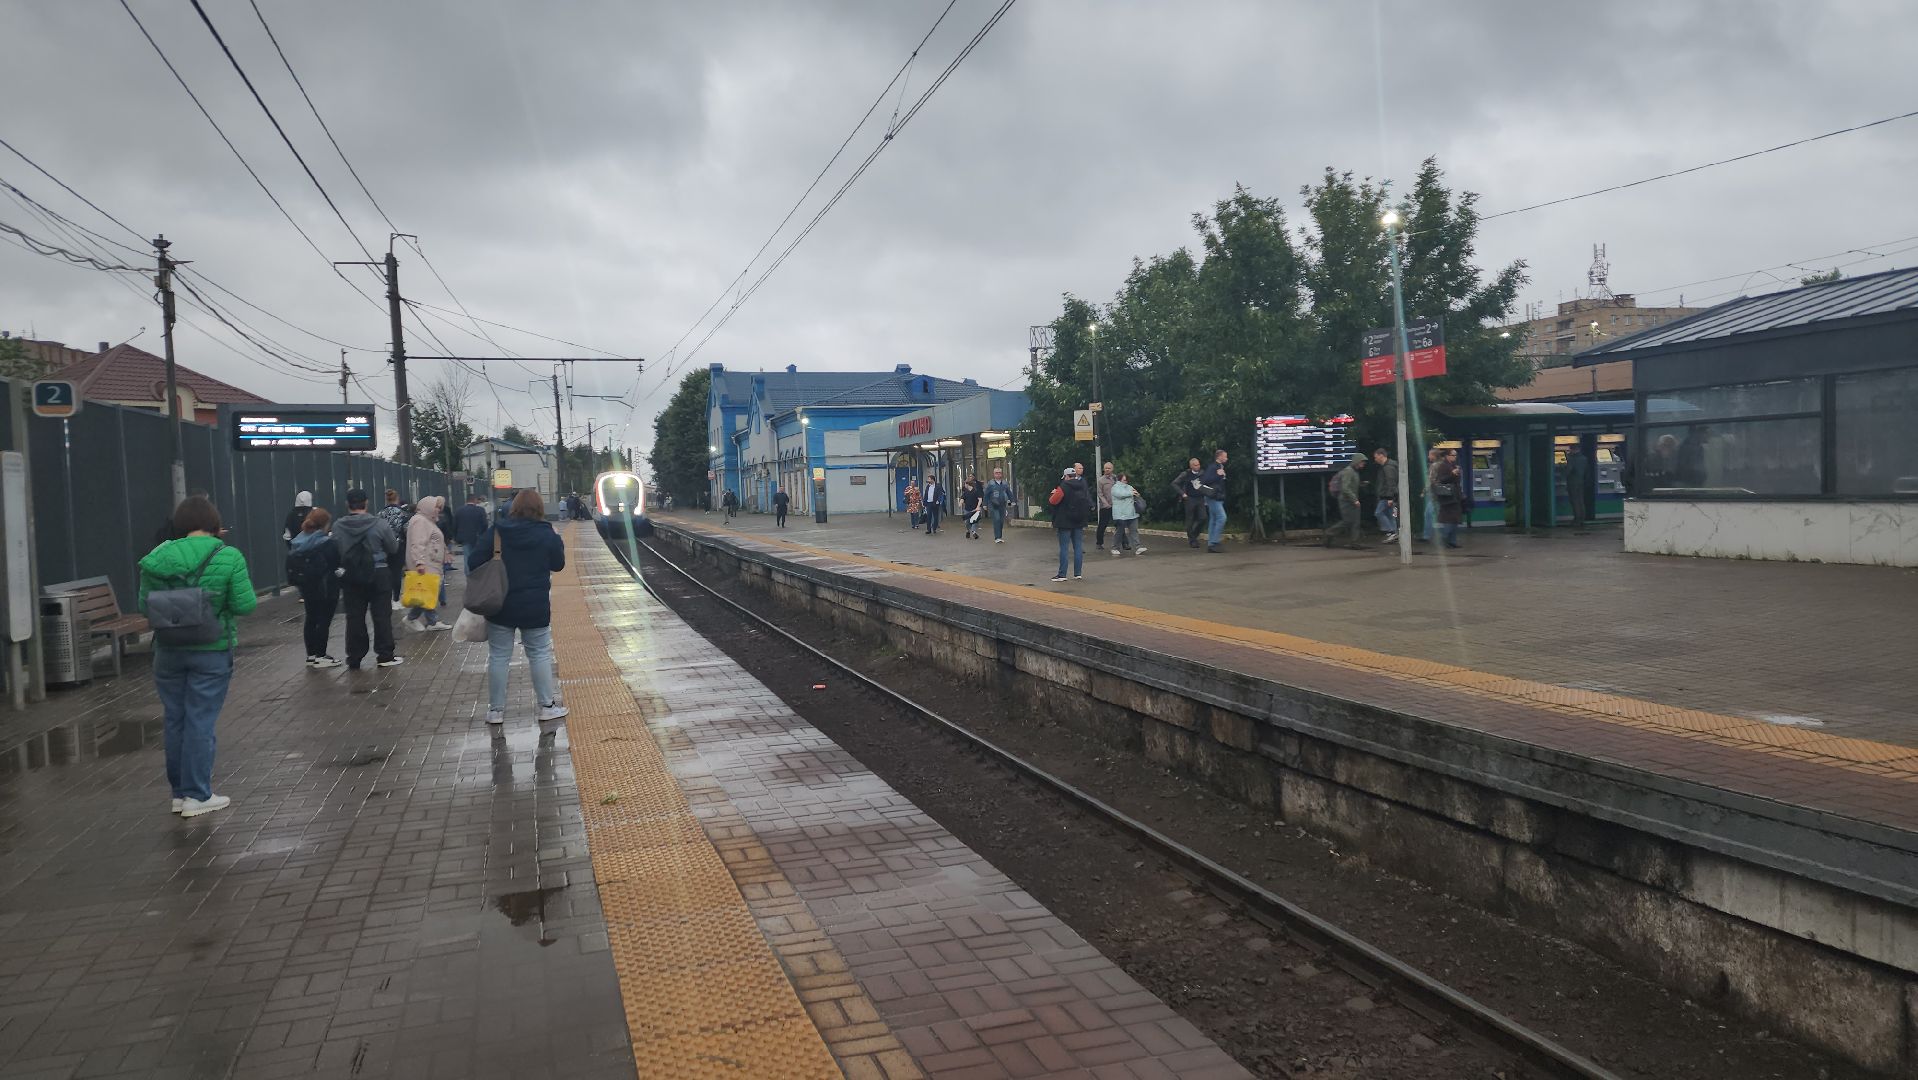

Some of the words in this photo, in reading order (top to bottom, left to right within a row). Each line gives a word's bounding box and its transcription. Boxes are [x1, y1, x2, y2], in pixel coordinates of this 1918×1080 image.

[1425, 323, 1432, 334] 2
[1368, 335, 1374, 345] 2
[1368, 347, 1374, 357] 6
[46, 385, 62, 404] 2
